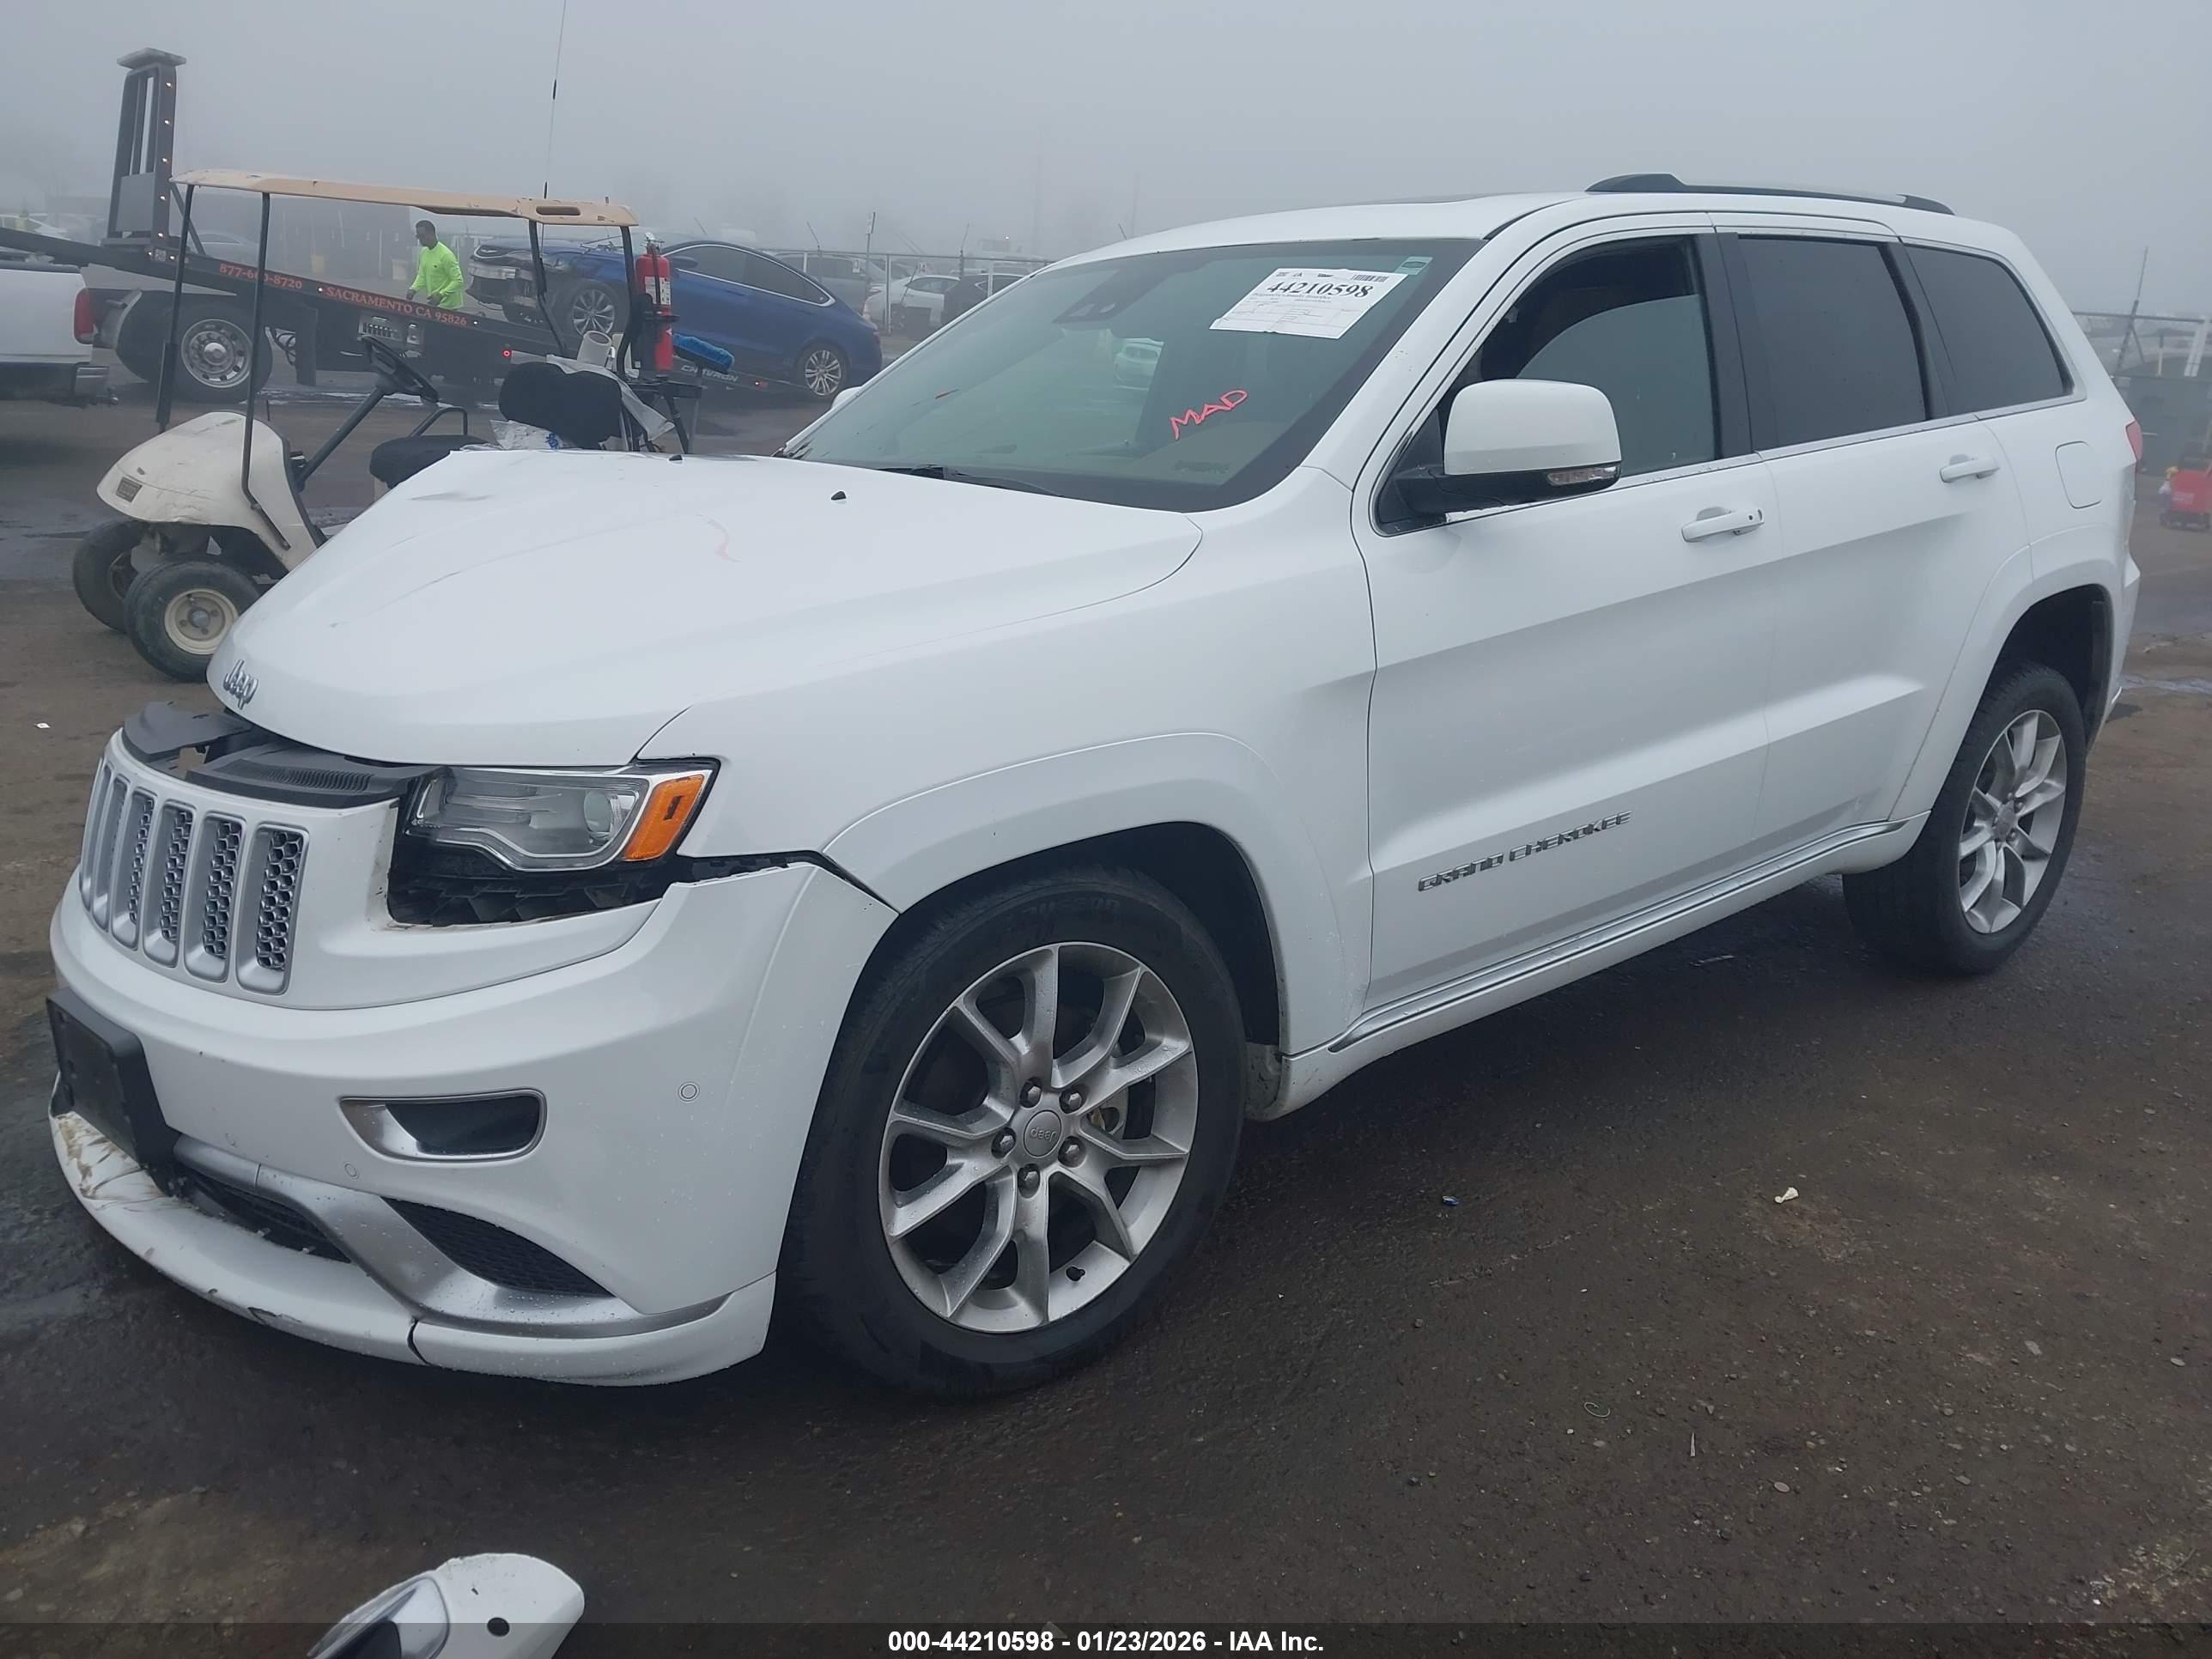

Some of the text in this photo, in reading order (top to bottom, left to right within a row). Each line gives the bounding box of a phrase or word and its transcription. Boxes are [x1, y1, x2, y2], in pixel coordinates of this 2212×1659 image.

[325, 287, 467, 325] SACRAMENTO CA 95826
[1267, 281, 1374, 299] 44210598
[1170, 390, 1248, 441] MAD
[223, 659, 259, 710] Jeep
[1418, 810, 1632, 891] GRAND CHEROKEE
[1030, 1127, 1057, 1141] Jeep
